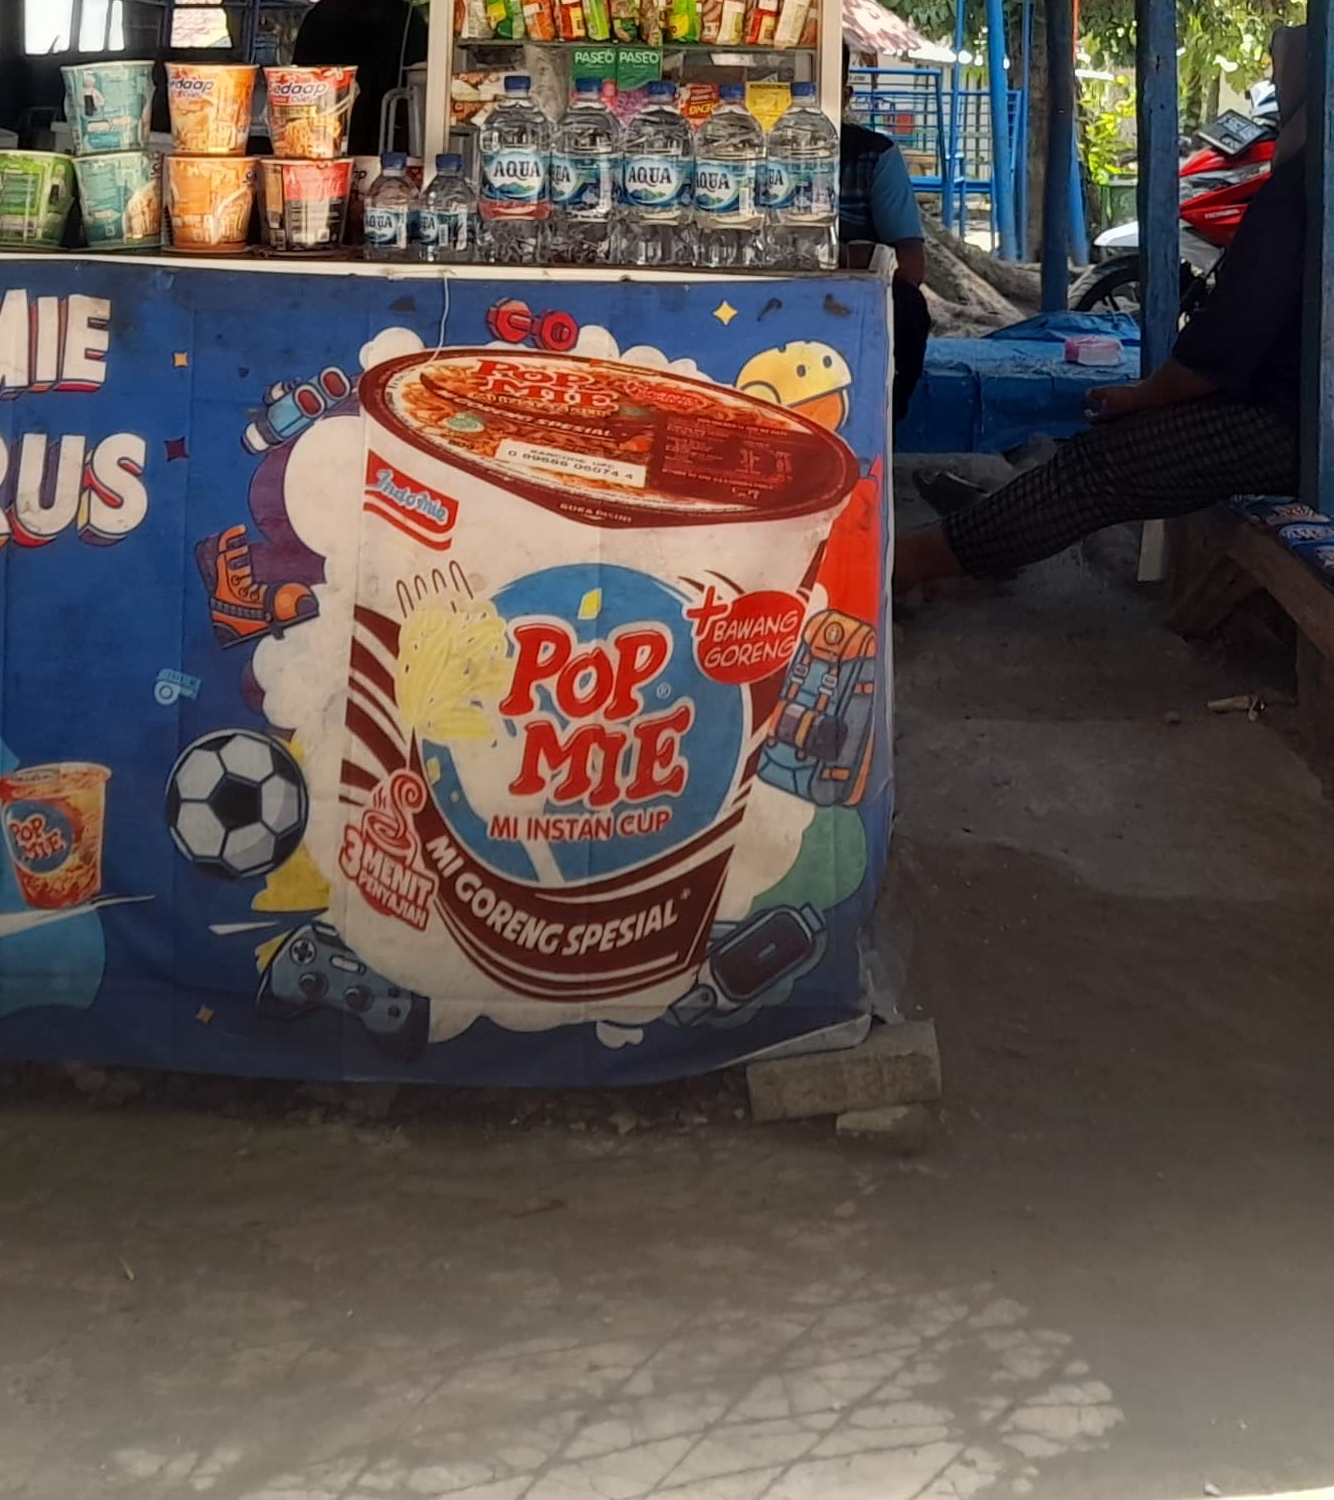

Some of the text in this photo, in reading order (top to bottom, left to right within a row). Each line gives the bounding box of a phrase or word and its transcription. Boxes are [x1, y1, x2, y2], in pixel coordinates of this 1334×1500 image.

[574, 50, 616, 64] PASEO
[619, 51, 660, 64] PASEO
[491, 159, 542, 179] AQUA
[627, 161, 673, 184] AQUA
[470, 359, 598, 391] POP
[713, 610, 799, 643] BAWANG
[704, 635, 796, 669] GORENG
[498, 618, 673, 720] POP
[508, 702, 693, 810] MIE
[10, 815, 44, 842] POP
[489, 808, 673, 841] MI INSTAN CUP
[21, 831, 67, 860] MIE
[363, 845, 436, 900] MENIT
[425, 835, 680, 957] MI GORENG SPESIAL
